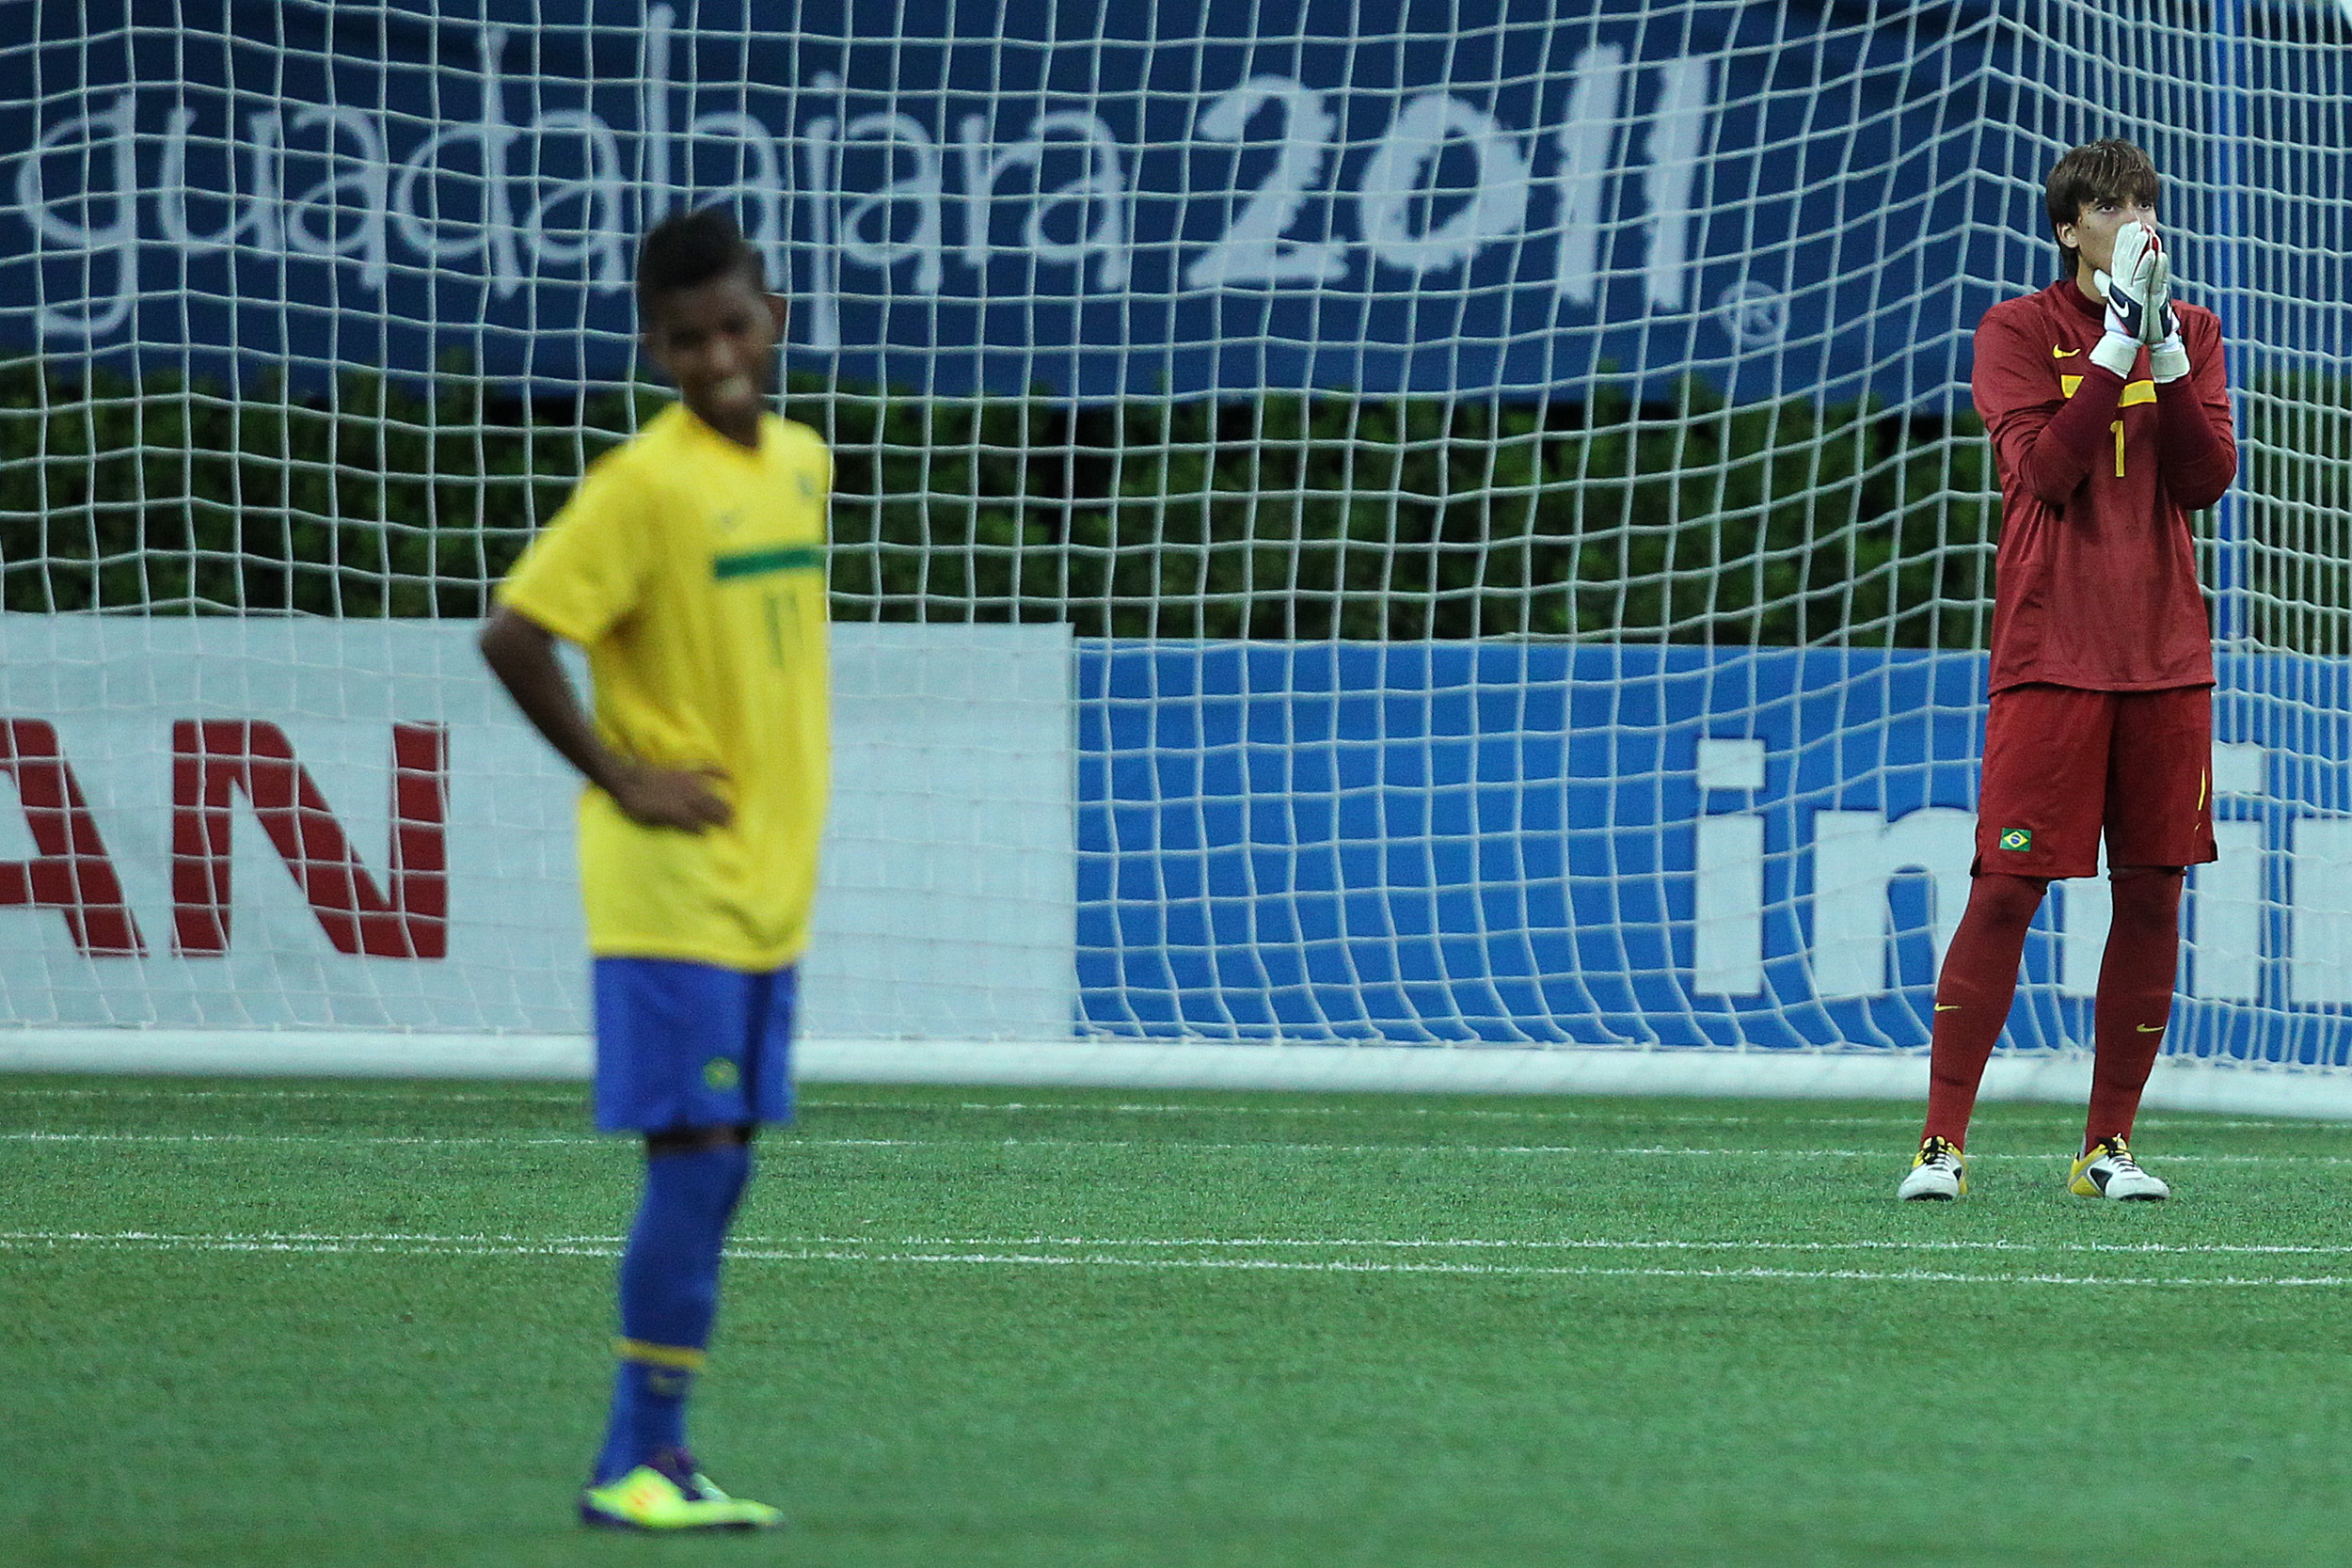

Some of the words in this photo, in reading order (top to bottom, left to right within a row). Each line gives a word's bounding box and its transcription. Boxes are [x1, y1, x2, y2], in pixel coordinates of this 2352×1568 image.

[15, 3, 1132, 349] guadalajara
[1186, 42, 1713, 311] 2011
[2109, 420, 2125, 477] 1
